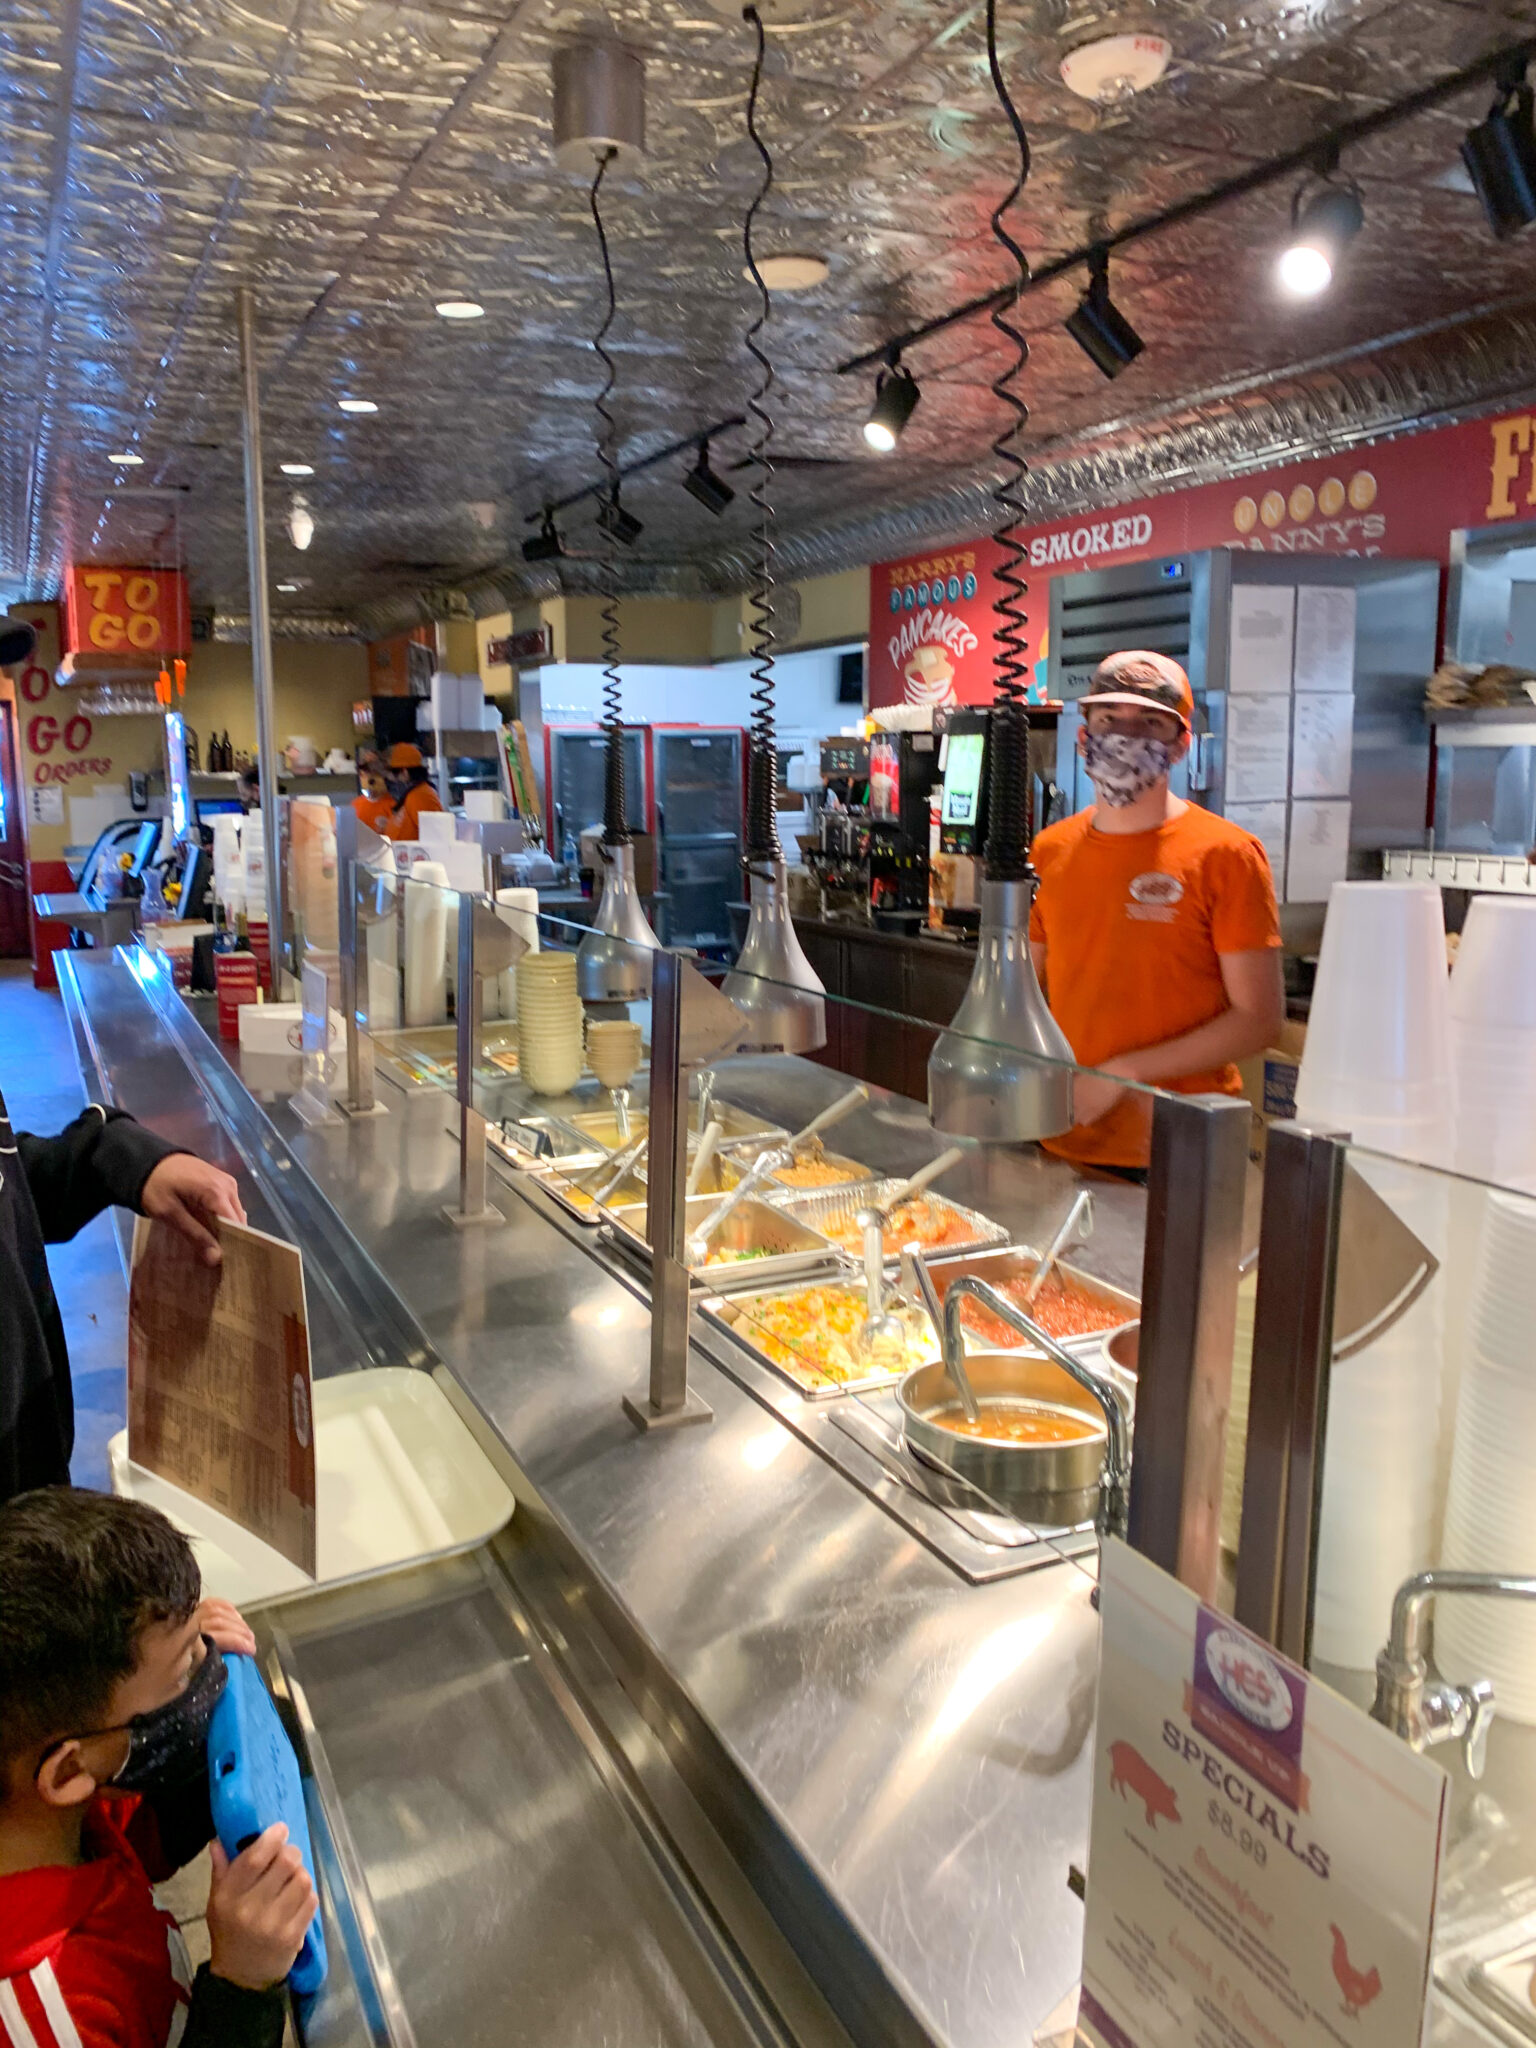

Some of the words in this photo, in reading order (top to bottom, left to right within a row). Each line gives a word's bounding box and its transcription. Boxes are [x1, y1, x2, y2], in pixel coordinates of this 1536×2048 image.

[1485, 413, 1536, 520] F
[1234, 472, 1376, 531] UNCLE
[1030, 513, 1153, 567] SMOKED
[84, 573, 160, 612] TO
[89, 612, 161, 650] GO
[888, 608, 979, 670] PANCAKES
[27, 714, 93, 755] GO
[34, 757, 113, 785] ORDERS
[1162, 1719, 1331, 1880] SPECIALS
[1207, 1800, 1268, 1869] $8.99
